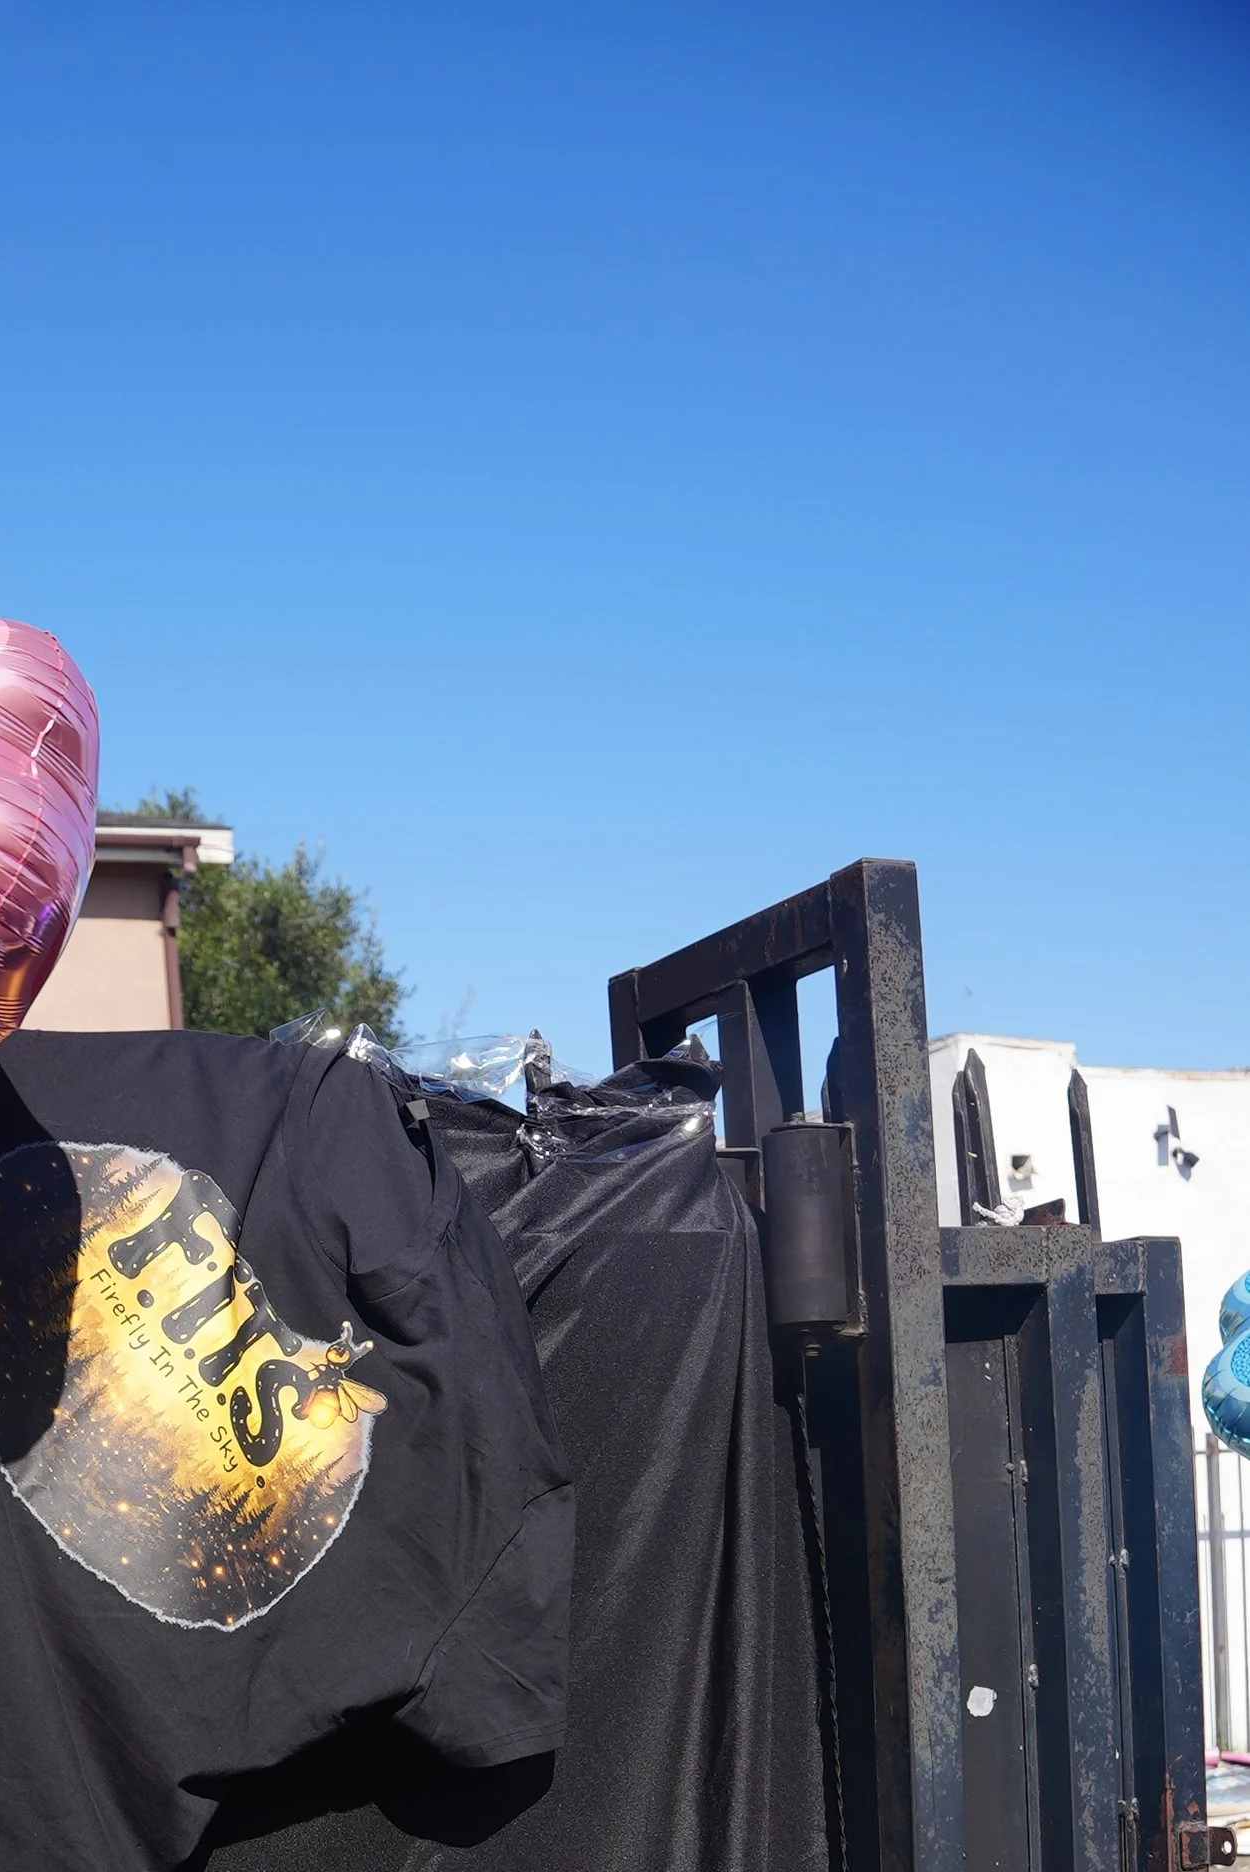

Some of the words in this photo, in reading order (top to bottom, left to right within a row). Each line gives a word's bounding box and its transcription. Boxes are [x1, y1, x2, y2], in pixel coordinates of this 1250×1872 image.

[90, 1268, 151, 1350] Firefly
[150, 1345, 175, 1378] In
[178, 1375, 210, 1422] The
[210, 1425, 239, 1473] Sky
